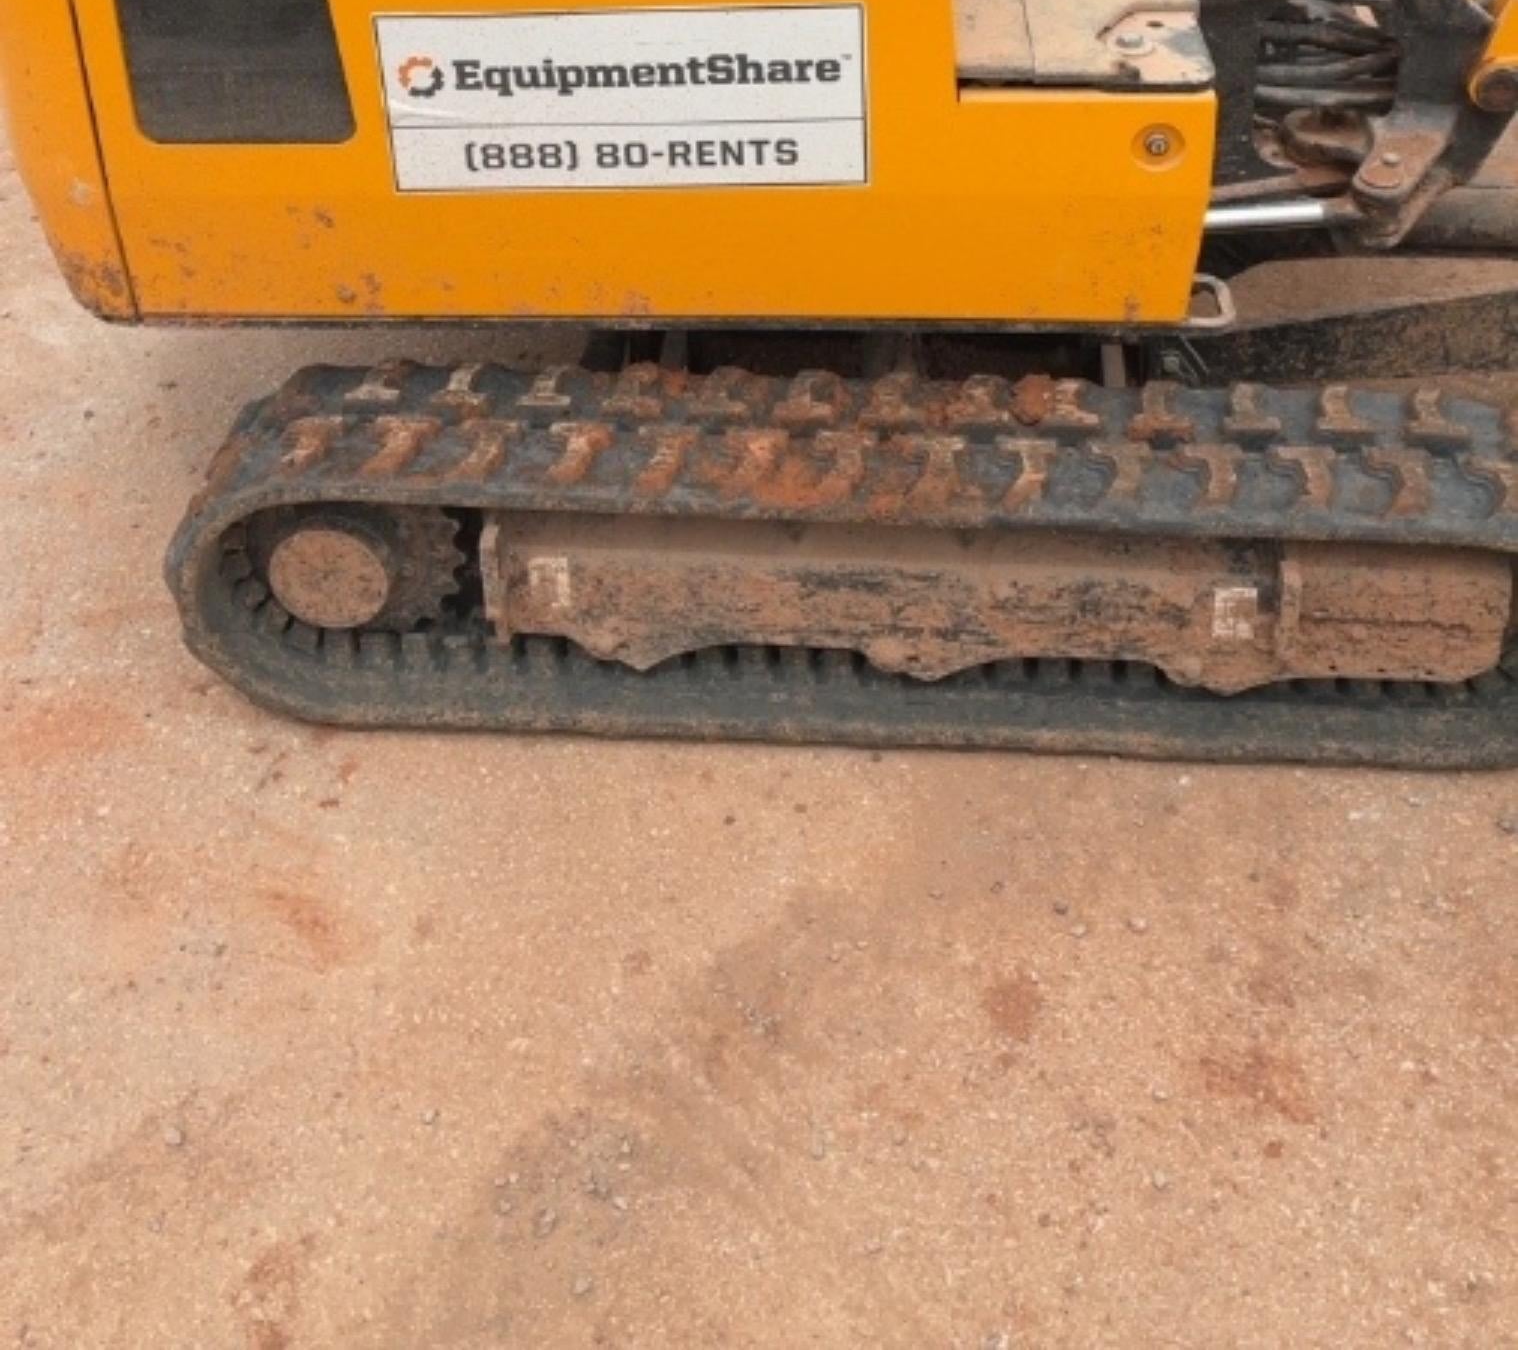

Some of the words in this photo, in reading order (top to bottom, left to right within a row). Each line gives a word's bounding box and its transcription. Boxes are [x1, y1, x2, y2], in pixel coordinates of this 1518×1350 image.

[451, 53, 842, 97] EquipmentShare
[464, 140, 579, 172] (888)
[595, 138, 800, 169] 80-RENTS
